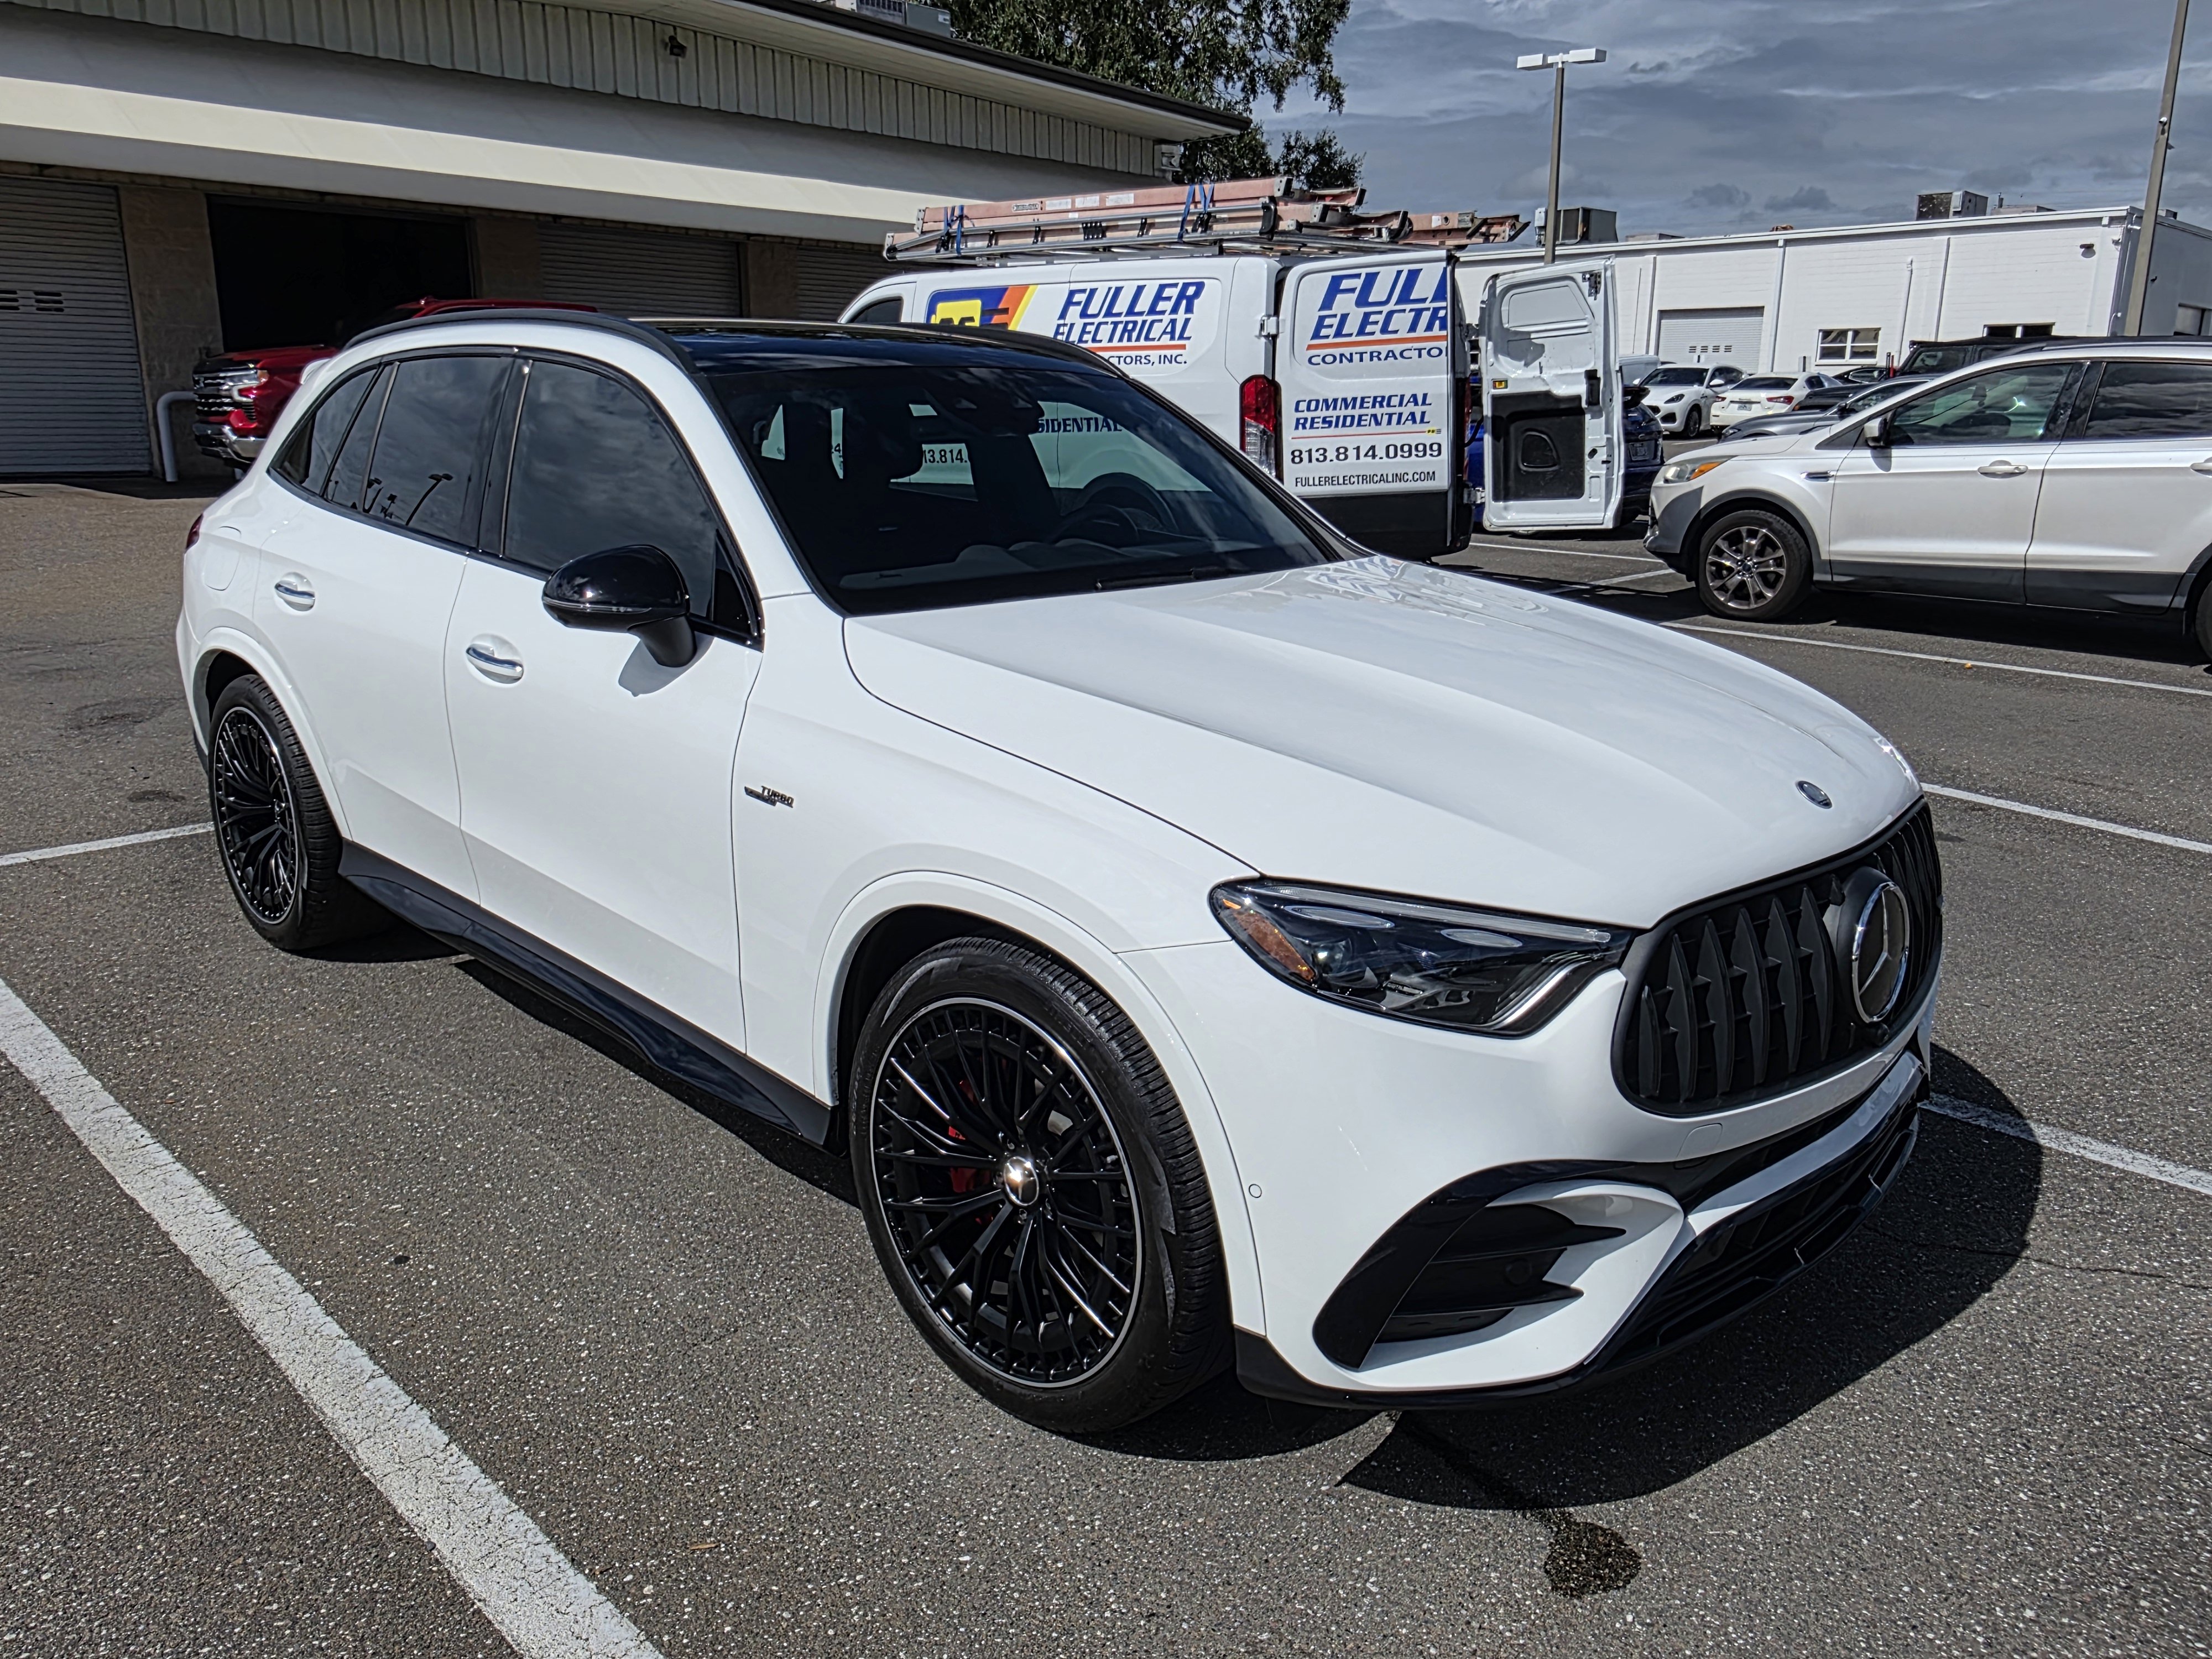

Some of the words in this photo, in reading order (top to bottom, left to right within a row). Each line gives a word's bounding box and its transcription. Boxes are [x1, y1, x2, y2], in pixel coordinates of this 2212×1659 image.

[1057, 281, 1206, 321] FULLER
[1053, 317, 1192, 345] ELECTRICAL
[1159, 354, 1187, 364] INC.
[1307, 346, 1447, 366] CONTRACTO
[1294, 393, 1432, 413] COMMERCIAL
[1294, 411, 1431, 431] RESIDENTIAL
[1290, 442, 1442, 465] 813.814.0999
[1295, 471, 1436, 487] FULLERELECTRICALINC.COM
[761, 785, 794, 805] TURBO
